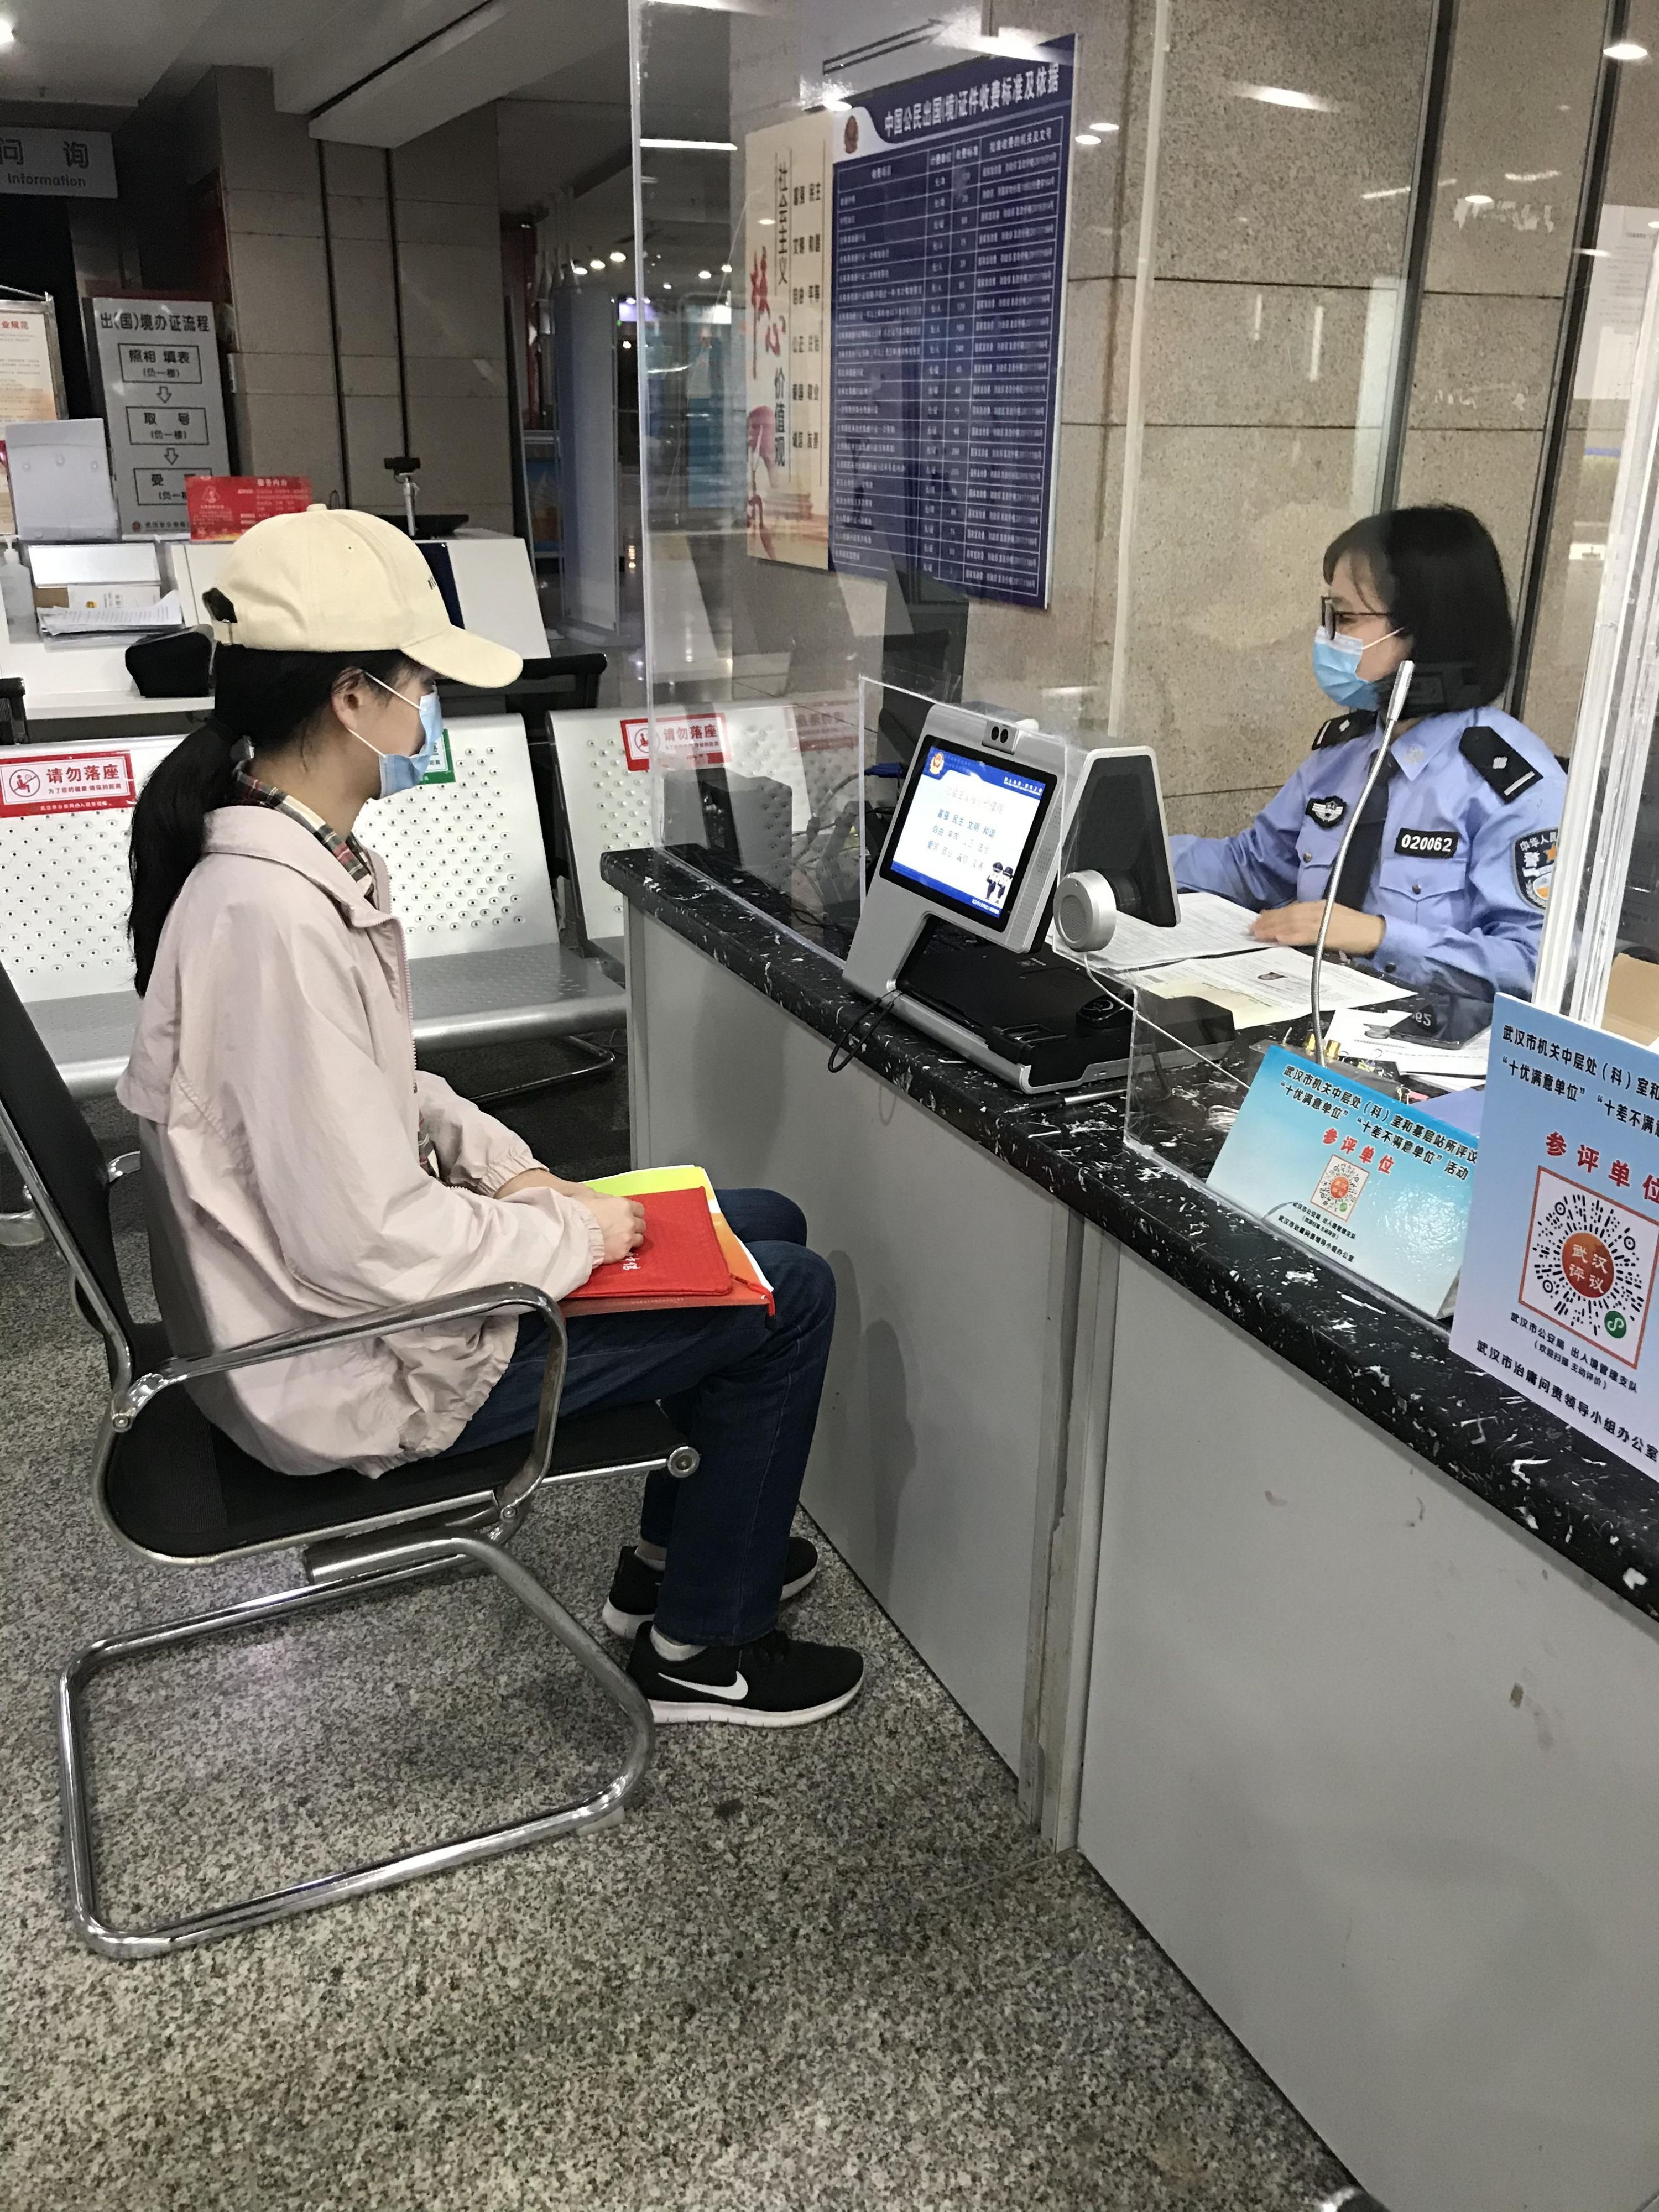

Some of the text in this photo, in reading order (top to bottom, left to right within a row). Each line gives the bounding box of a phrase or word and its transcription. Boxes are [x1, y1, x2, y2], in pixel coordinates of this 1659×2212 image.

[0, 139, 89, 169] 问询
[8, 173, 86, 186] Information
[0, 320, 29, 330] 业规范
[100, 312, 210, 332] 出(国)境办证流程
[163, 351, 190, 364] 填表
[144, 413, 190, 425] 取号
[664, 724, 717, 741] 请勿落座
[46, 764, 119, 784] 请勿落座
[1401, 834, 1453, 853] 020062
[1503, 1025, 1659, 1100] 武汉市机关中层处（科）室和
[1503, 1056, 1585, 1102] “十优满意单位”
[1281, 1082, 1469, 1180] “十优满意单位” “十差不满意单位” 活动
[1323, 1128, 1394, 1175] 参评单位
[1546, 1131, 1659, 1203] 参评单位
[1572, 1244, 1607, 1274] 武汉
[1569, 1263, 1604, 1293] 评议
[1510, 1312, 1637, 1393] 武汉市公安局 出入境管理支队
